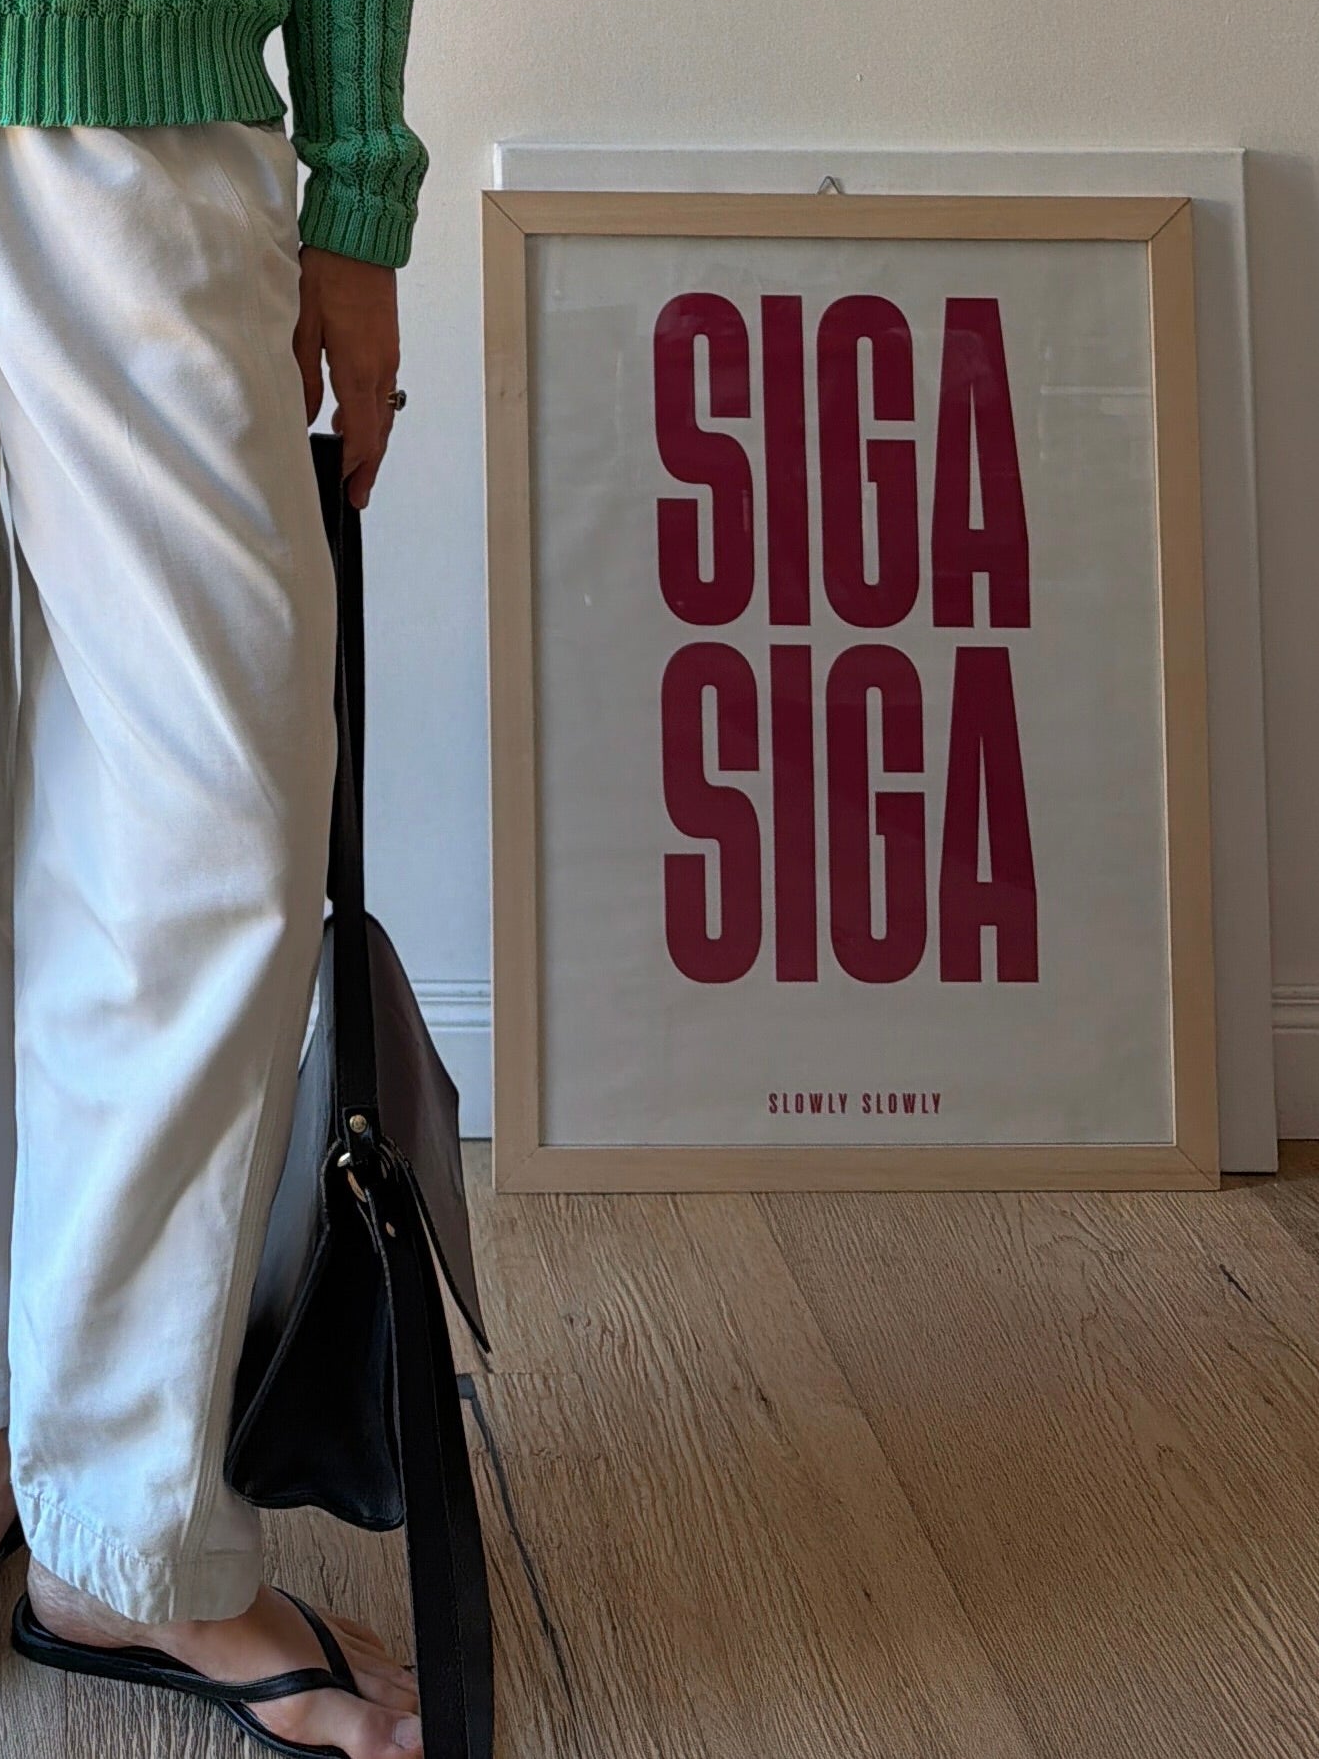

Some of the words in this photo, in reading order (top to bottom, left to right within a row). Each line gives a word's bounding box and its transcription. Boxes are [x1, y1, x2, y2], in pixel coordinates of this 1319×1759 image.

[653, 292, 1031, 628] SIGA
[661, 642, 1039, 983] SIGA
[768, 1092, 848, 1115] SLOWLY
[861, 1092, 942, 1115] SLOWLY
